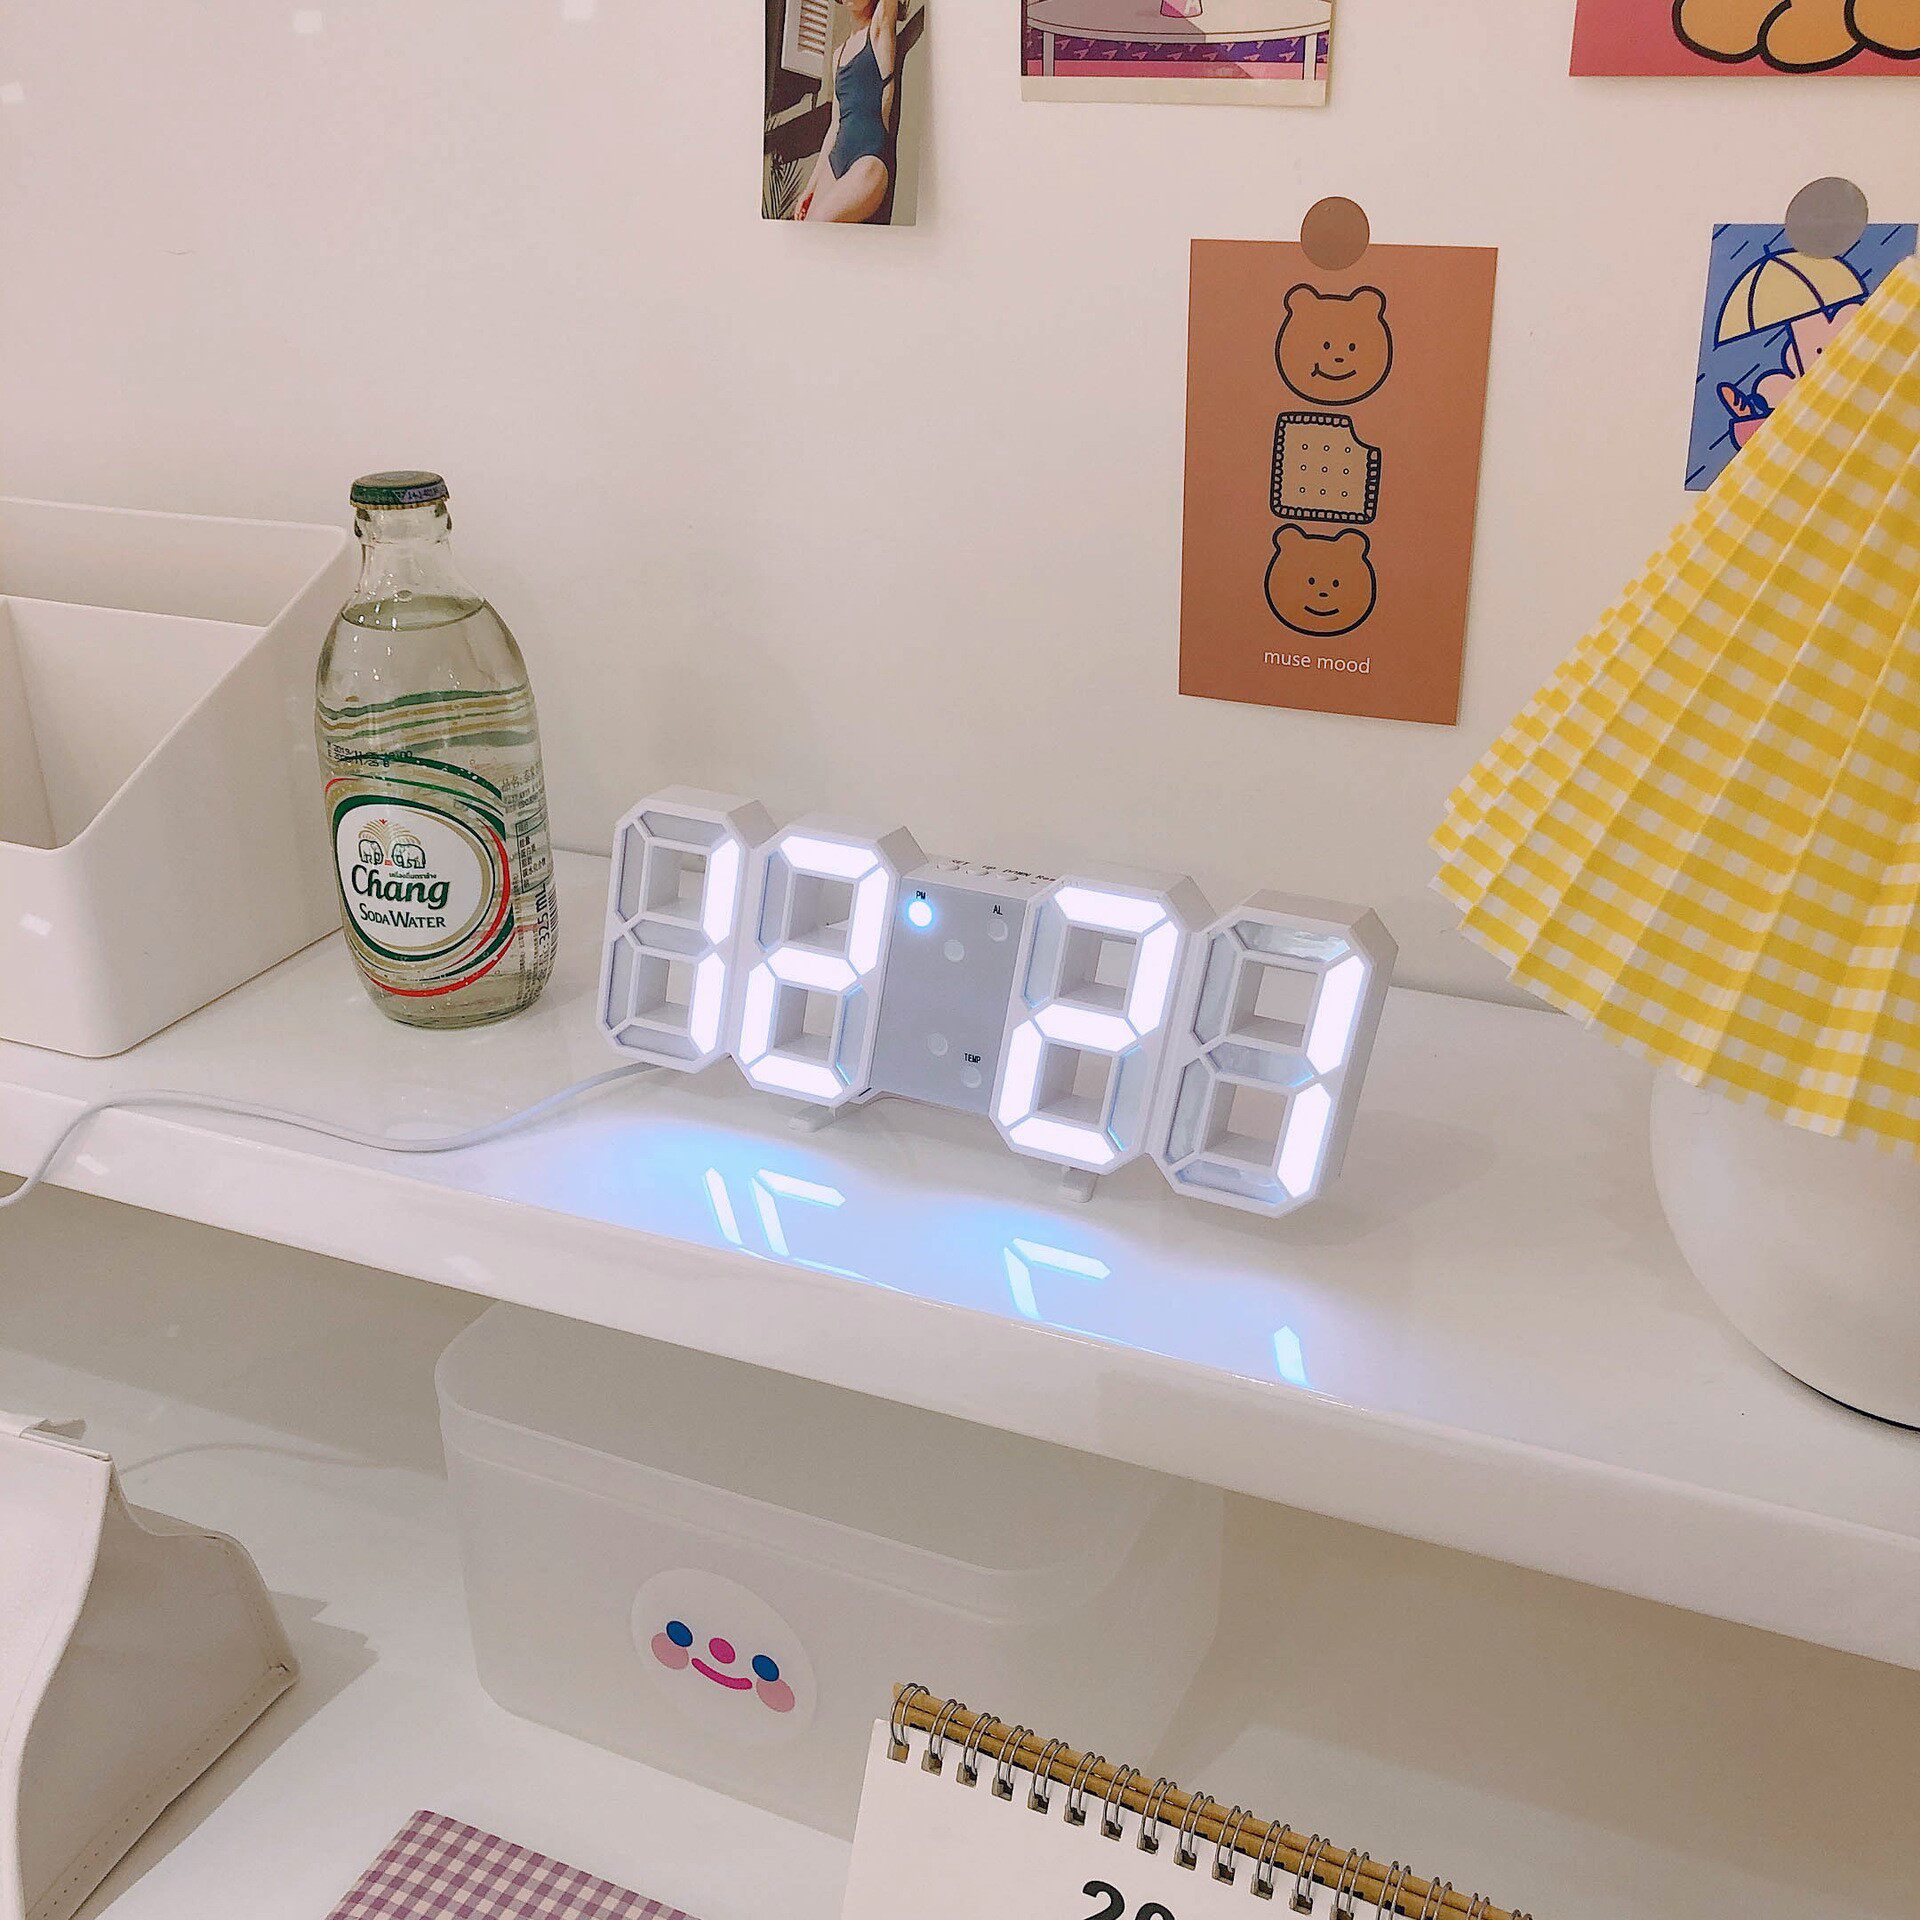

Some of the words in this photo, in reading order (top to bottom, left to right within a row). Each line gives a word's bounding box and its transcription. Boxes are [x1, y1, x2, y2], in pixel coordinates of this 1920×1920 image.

[1264, 651, 1311, 668] muse
[1317, 657, 1371, 674] mood
[351, 864, 451, 910] Chang
[915, 890, 927, 900] PM
[359, 902, 391, 926] SODA
[388, 909, 447, 929] WATER
[992, 904, 1004, 915] AL
[964, 1052, 982, 1064] TEMP
